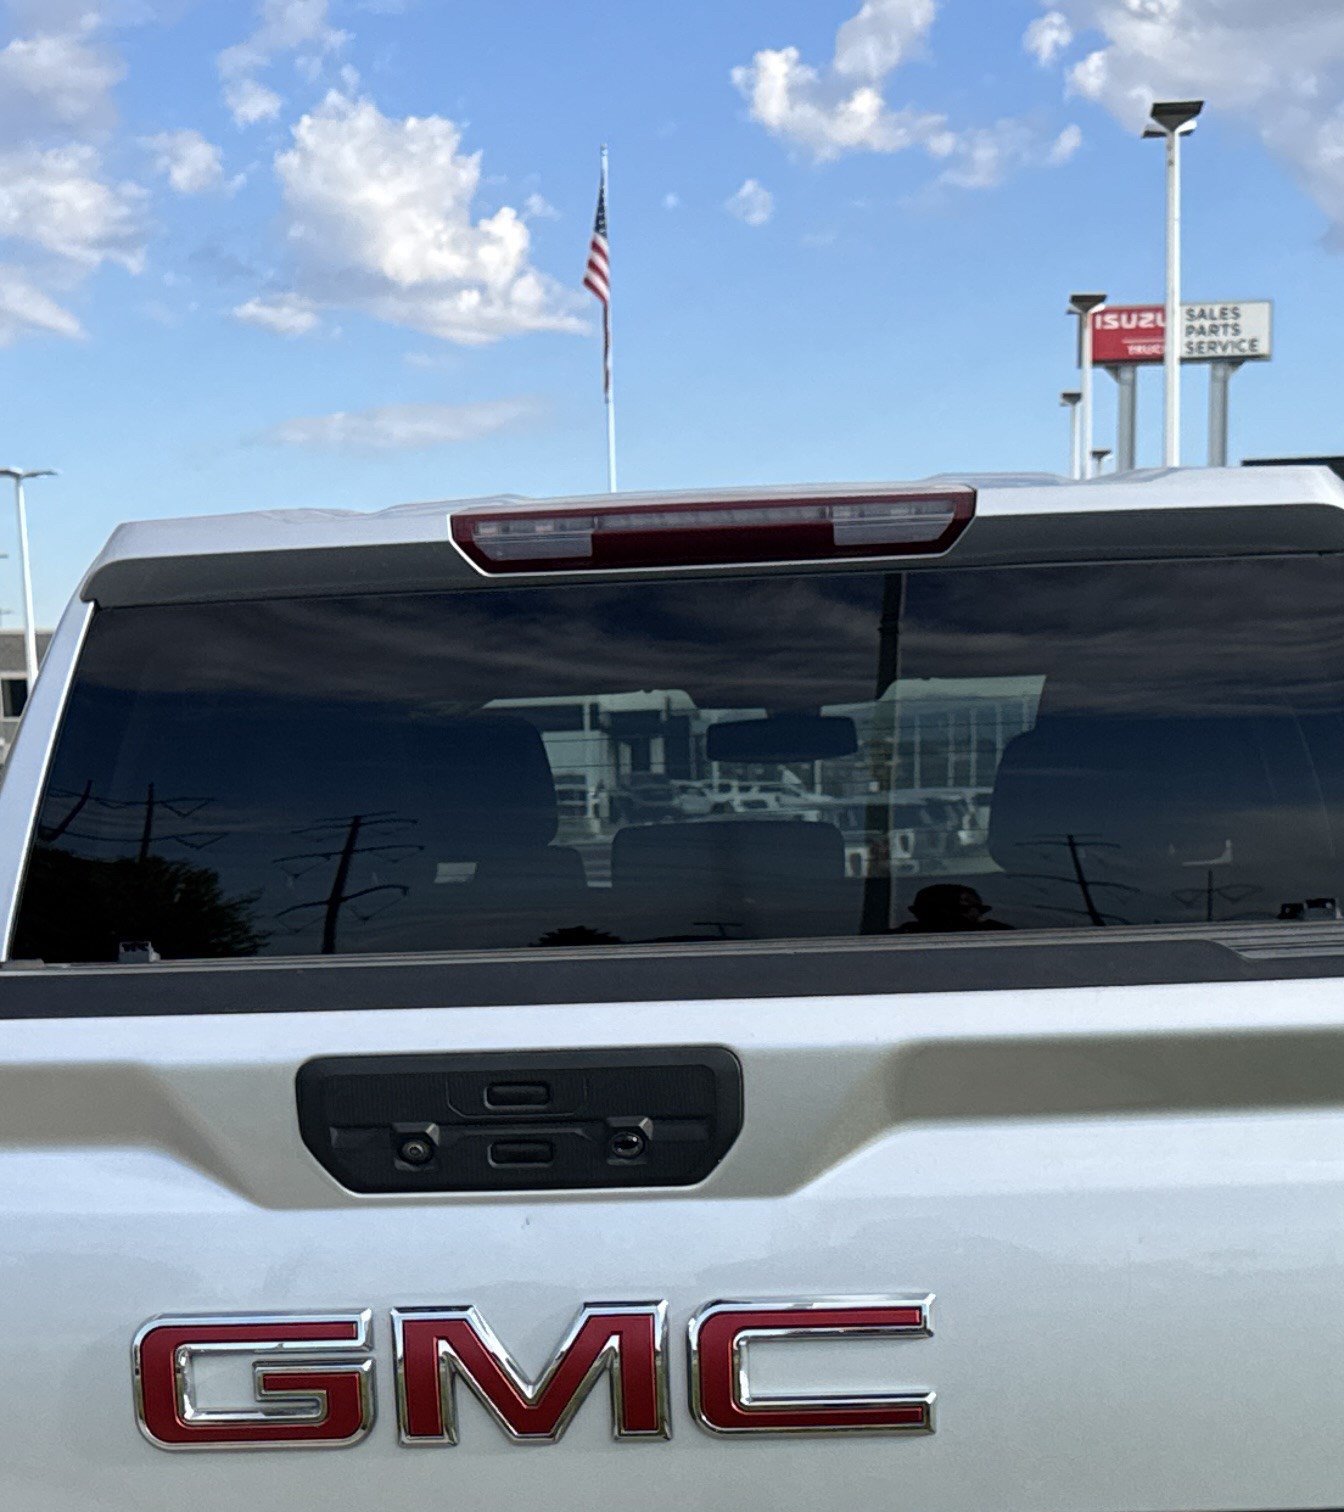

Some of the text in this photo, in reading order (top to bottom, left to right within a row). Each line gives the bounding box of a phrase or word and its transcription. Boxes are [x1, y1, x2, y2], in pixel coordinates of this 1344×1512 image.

[1185, 306, 1241, 322] SALES
[1185, 323, 1241, 337] PARTS
[1185, 338, 1259, 354] SERVICE
[130, 1291, 937, 1452] GMC
